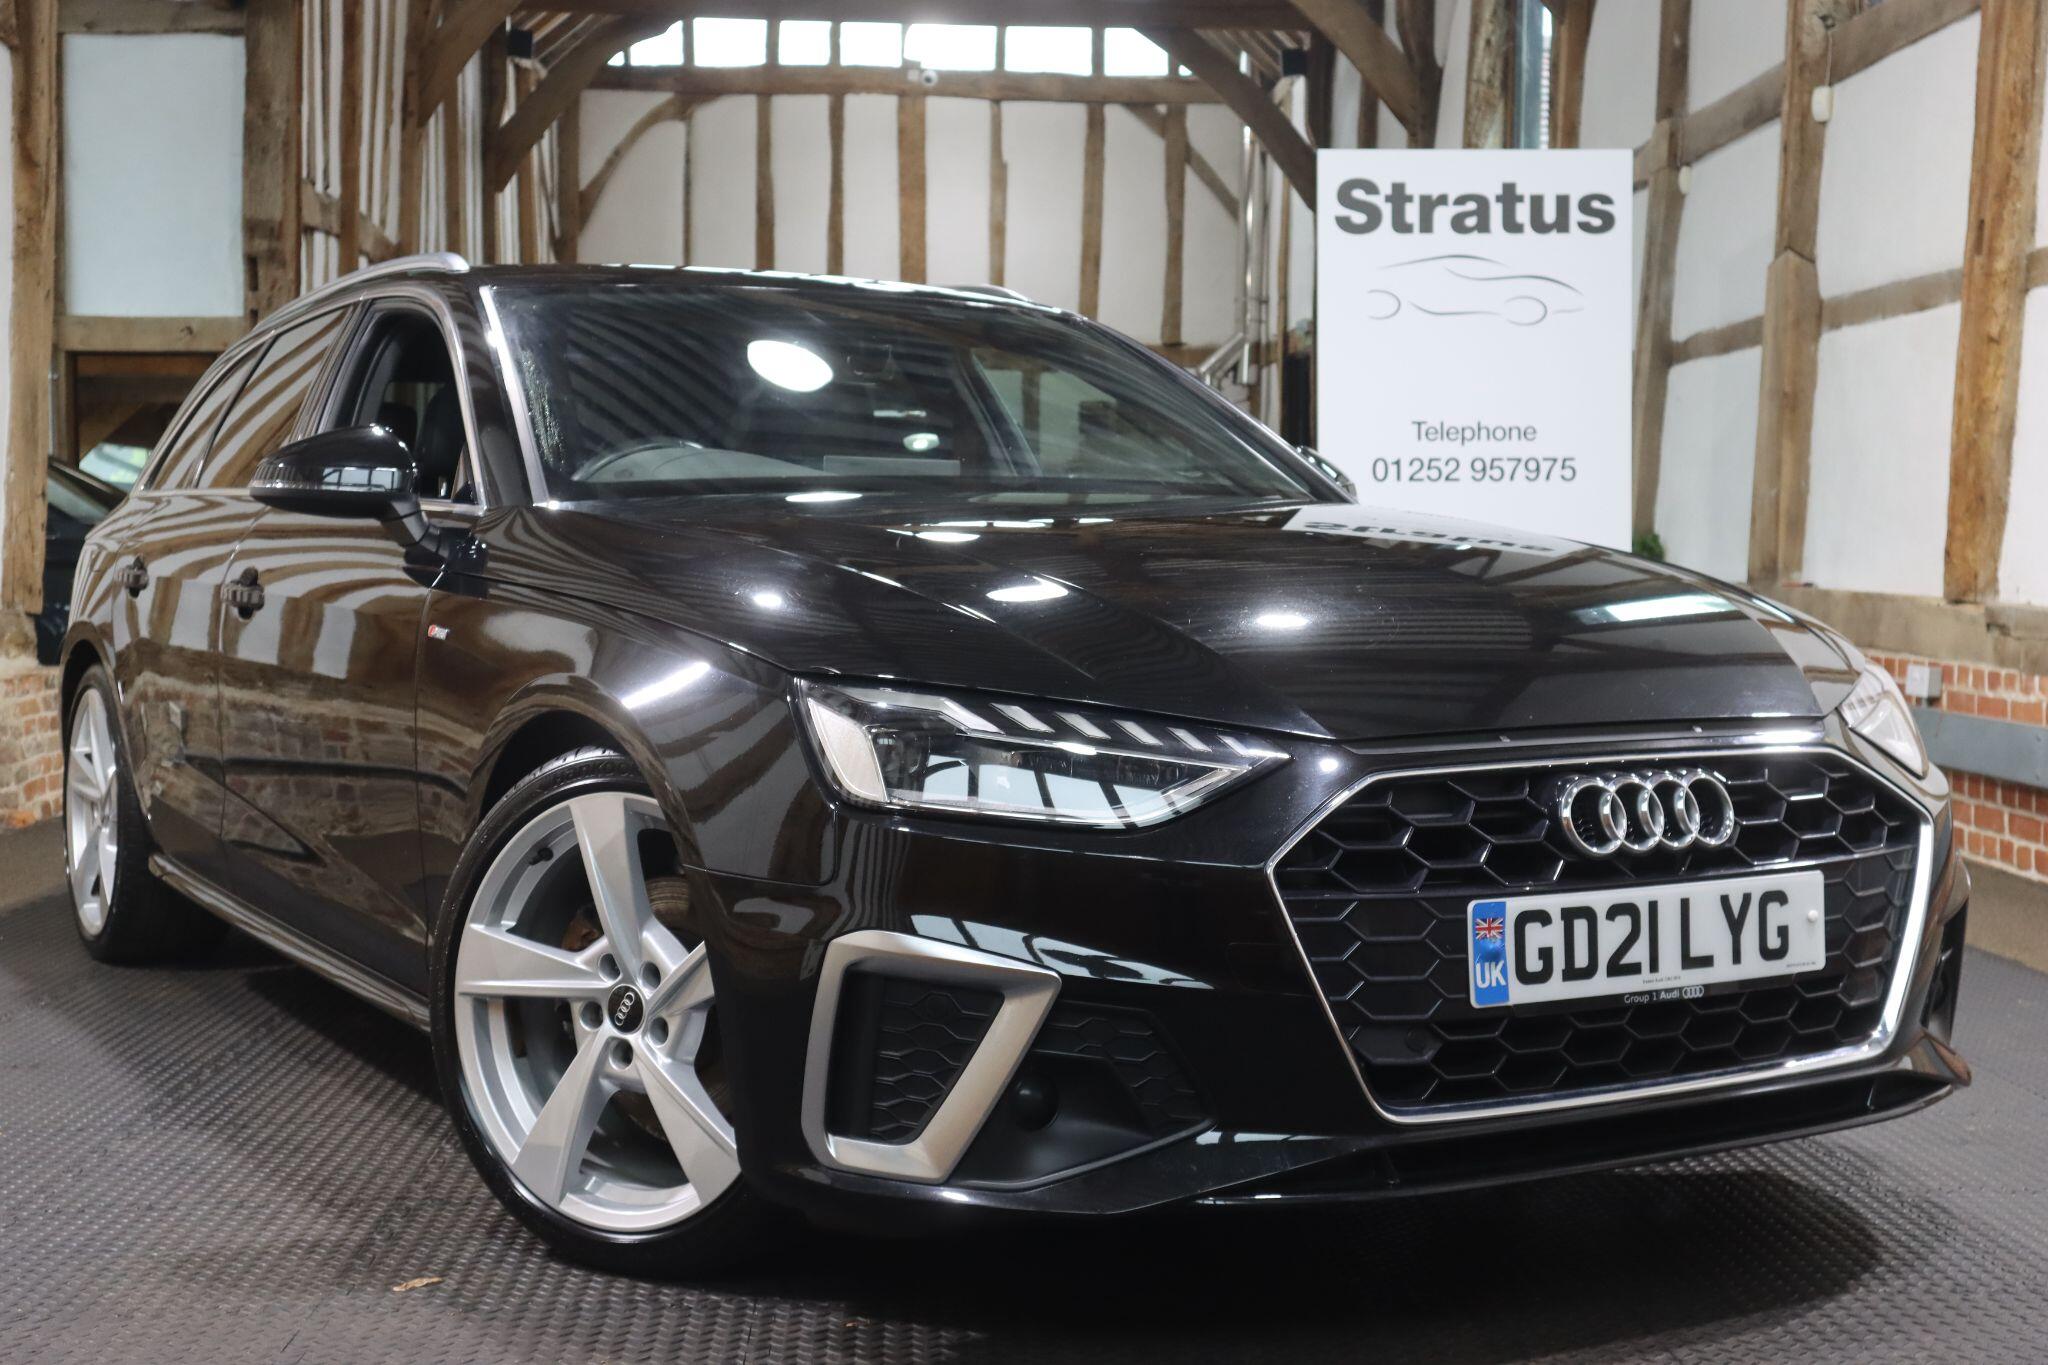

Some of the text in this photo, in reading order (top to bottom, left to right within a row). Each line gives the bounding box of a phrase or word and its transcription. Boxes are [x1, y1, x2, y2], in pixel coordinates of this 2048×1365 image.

[1335, 178, 1616, 235] Stratus
[1412, 420, 1538, 446] Telephone
[1372, 457, 1577, 483] 01252 957975
[1513, 890, 1789, 986] GD21 LYG
[1475, 960, 1507, 989] UK
[1624, 994, 1650, 1004] Group
[1660, 989, 1680, 1000] Audi
